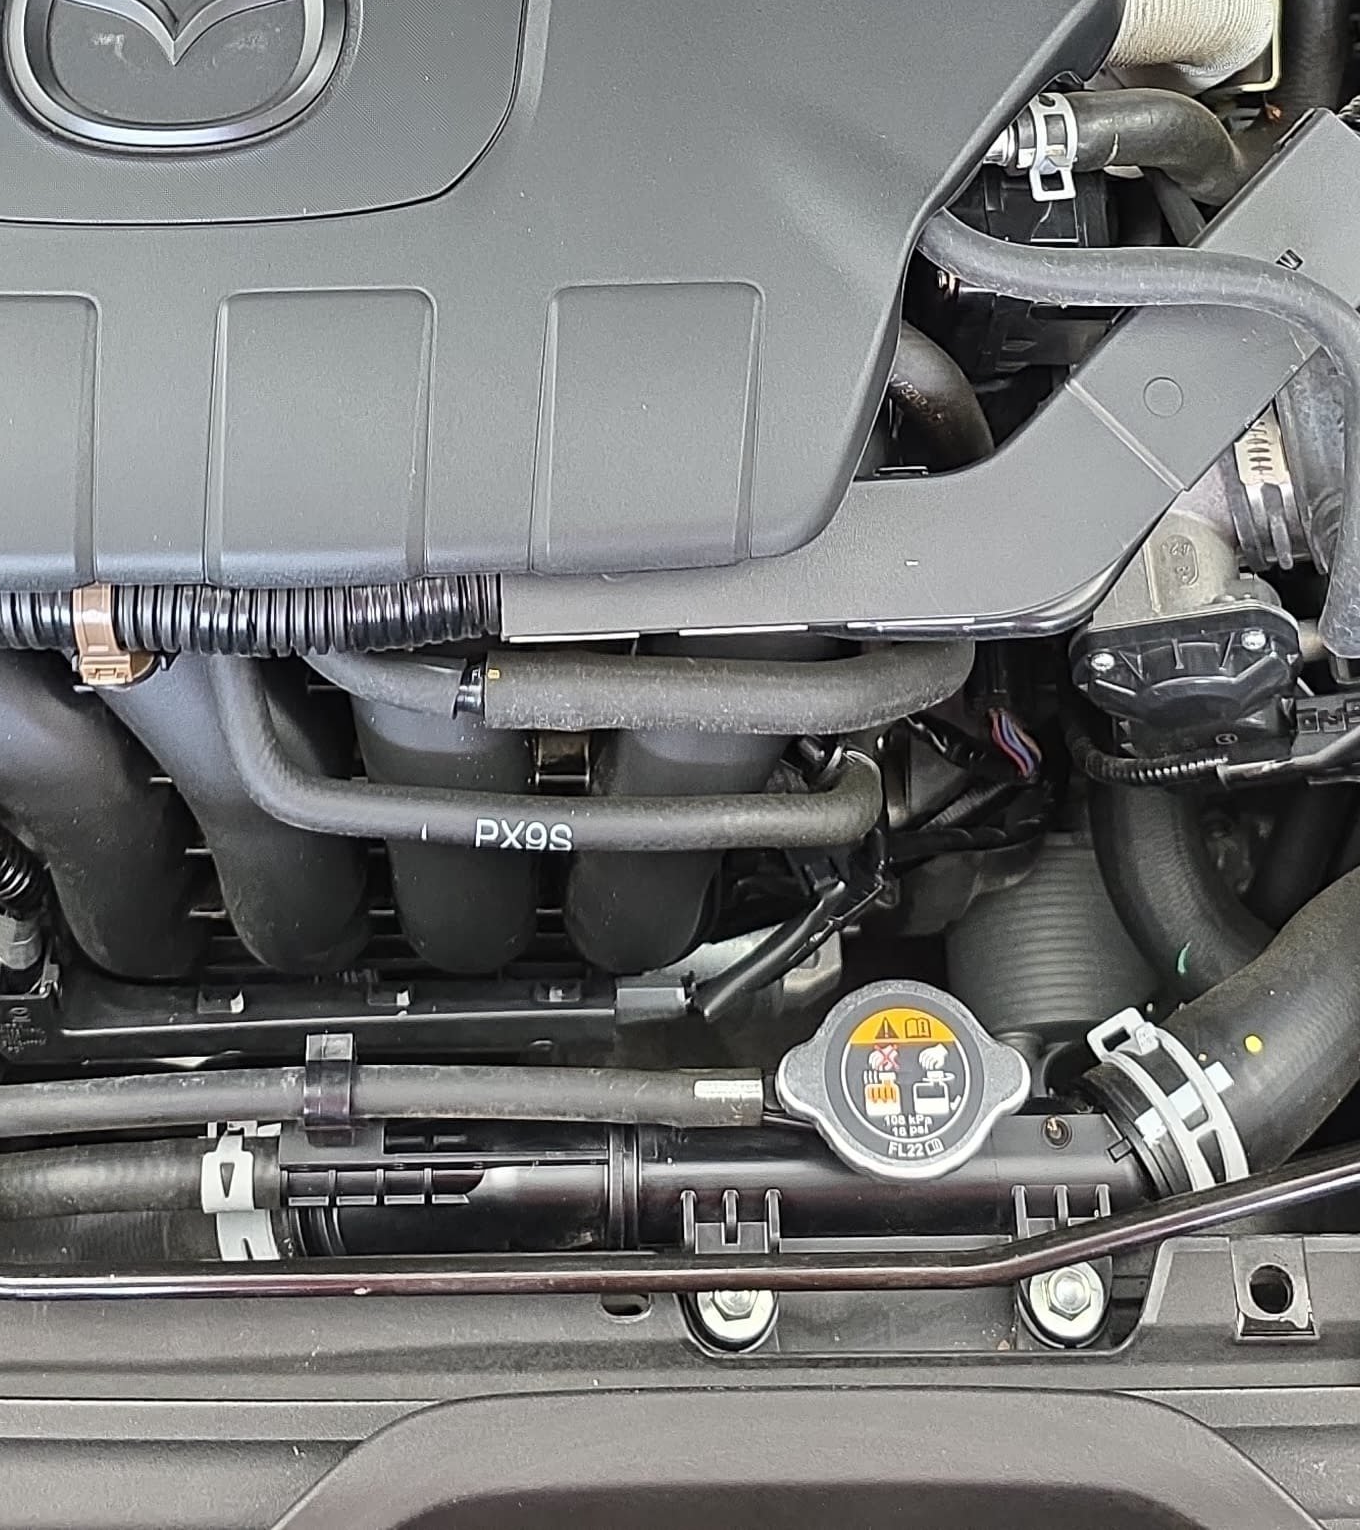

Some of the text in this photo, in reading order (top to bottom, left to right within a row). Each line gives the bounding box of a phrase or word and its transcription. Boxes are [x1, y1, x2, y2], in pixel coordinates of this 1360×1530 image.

[474, 817, 574, 852] PX9S
[884, 1114, 933, 1126] 108 kPa
[909, 1125, 930, 1137] psi
[888, 1141, 925, 1158] FL22
